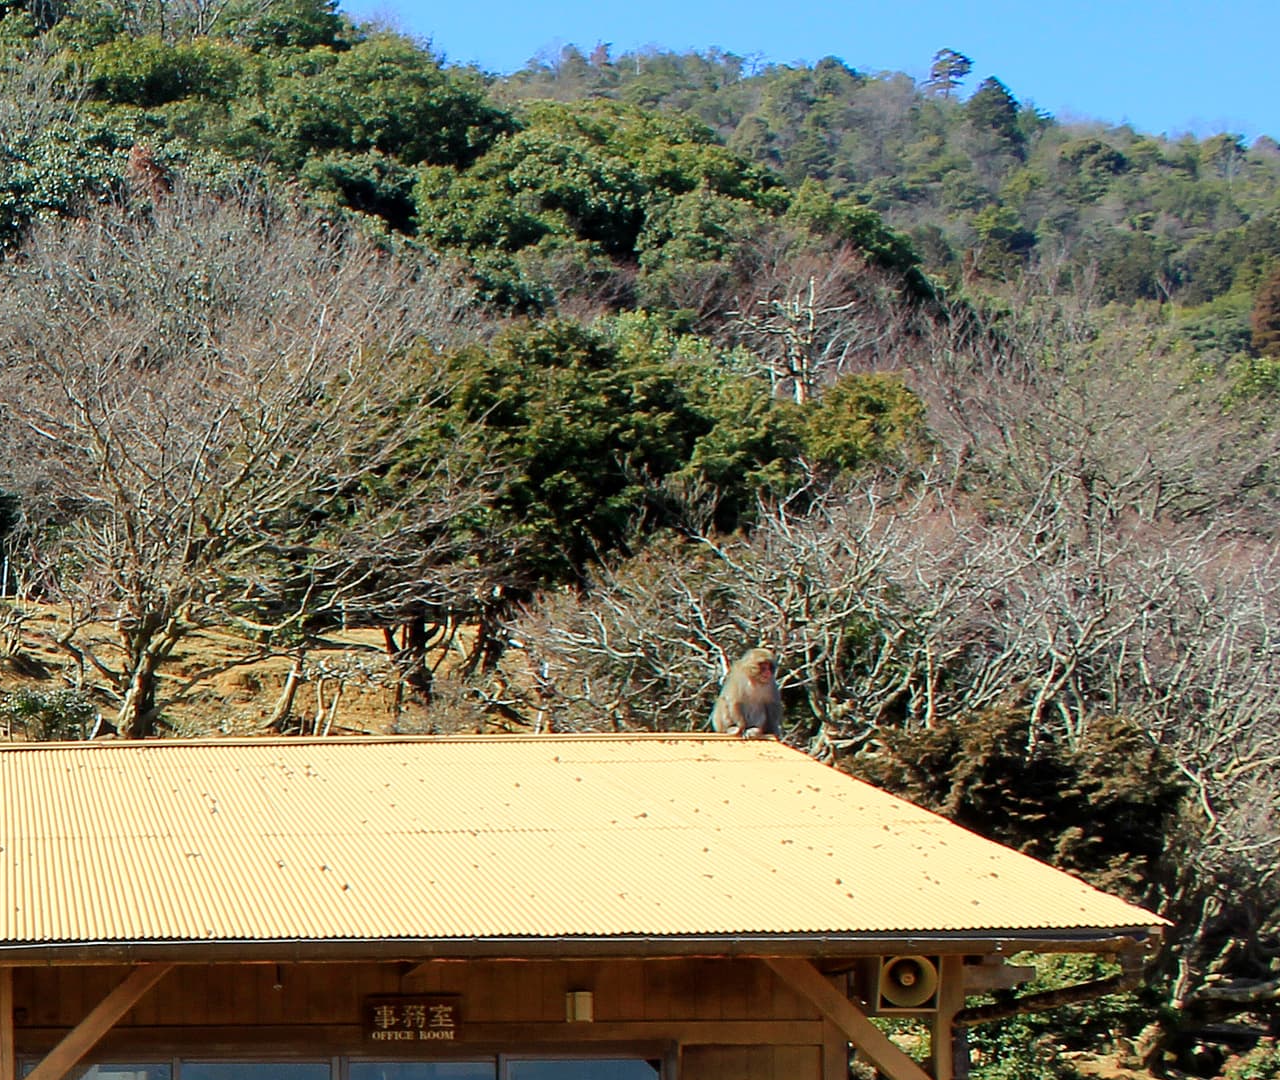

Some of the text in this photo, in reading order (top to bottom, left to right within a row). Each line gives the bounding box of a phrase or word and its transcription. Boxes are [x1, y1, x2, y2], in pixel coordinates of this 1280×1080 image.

[373, 1004, 455, 1029] 事務室
[372, 1030, 454, 1040] OFFICE ROOM
